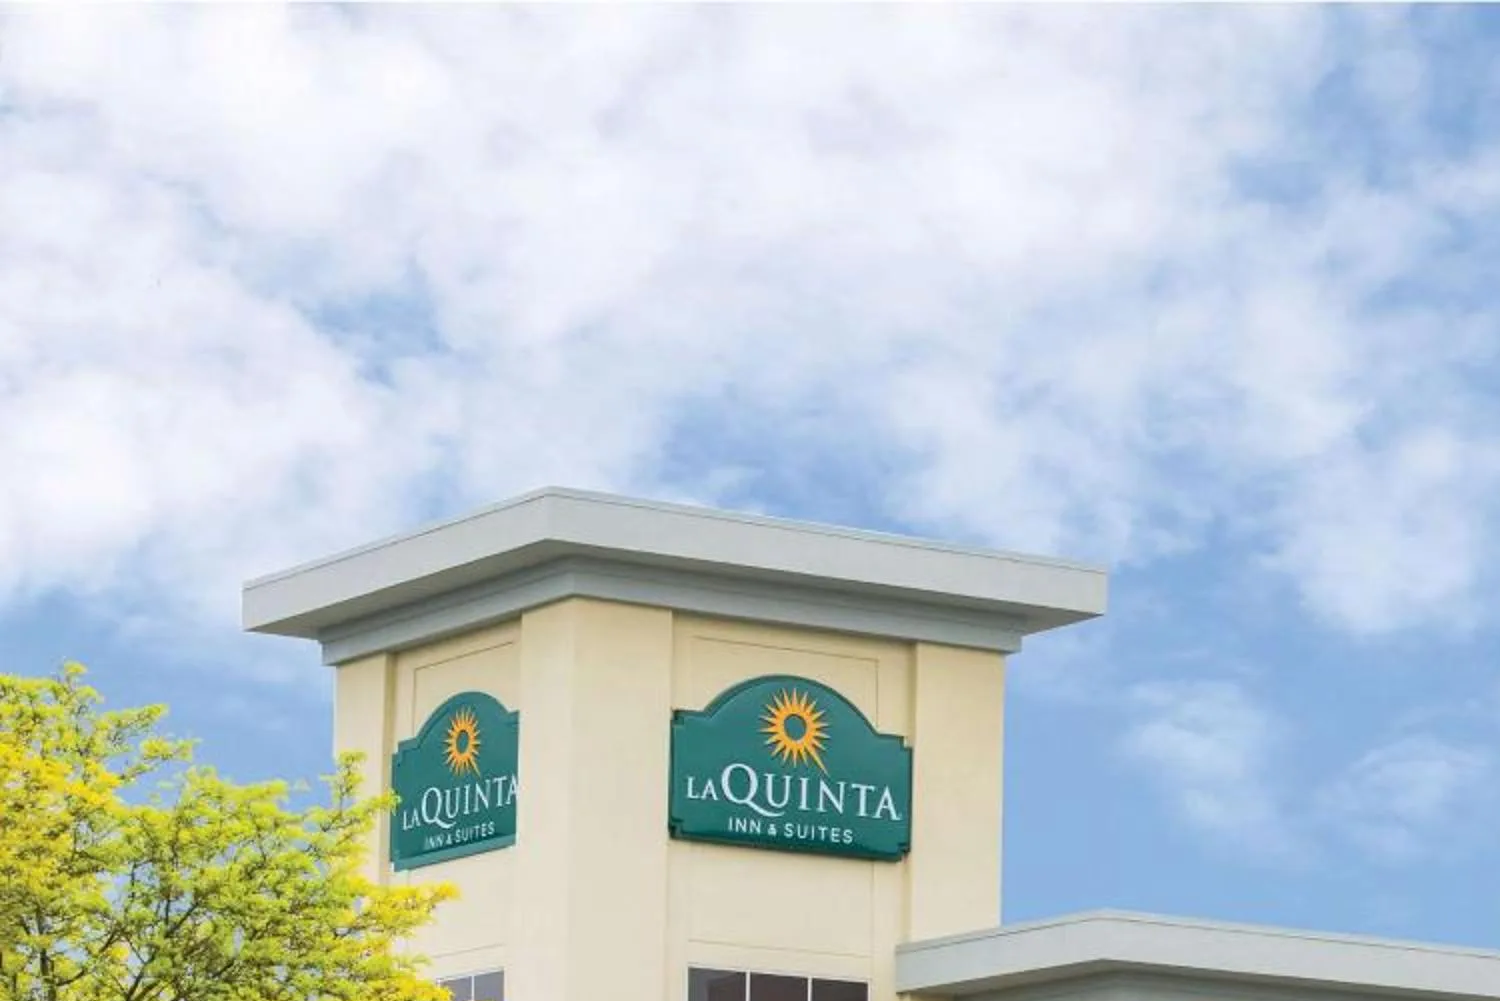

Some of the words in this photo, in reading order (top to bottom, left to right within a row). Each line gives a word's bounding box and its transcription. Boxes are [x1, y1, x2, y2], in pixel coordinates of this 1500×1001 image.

[686, 776, 718, 801] LA
[721, 763, 902, 821] QUINTA
[455, 821, 495, 843] SUITES
[728, 816, 761, 834] INN
[767, 823, 778, 837] &
[783, 822, 854, 844] SUITES
